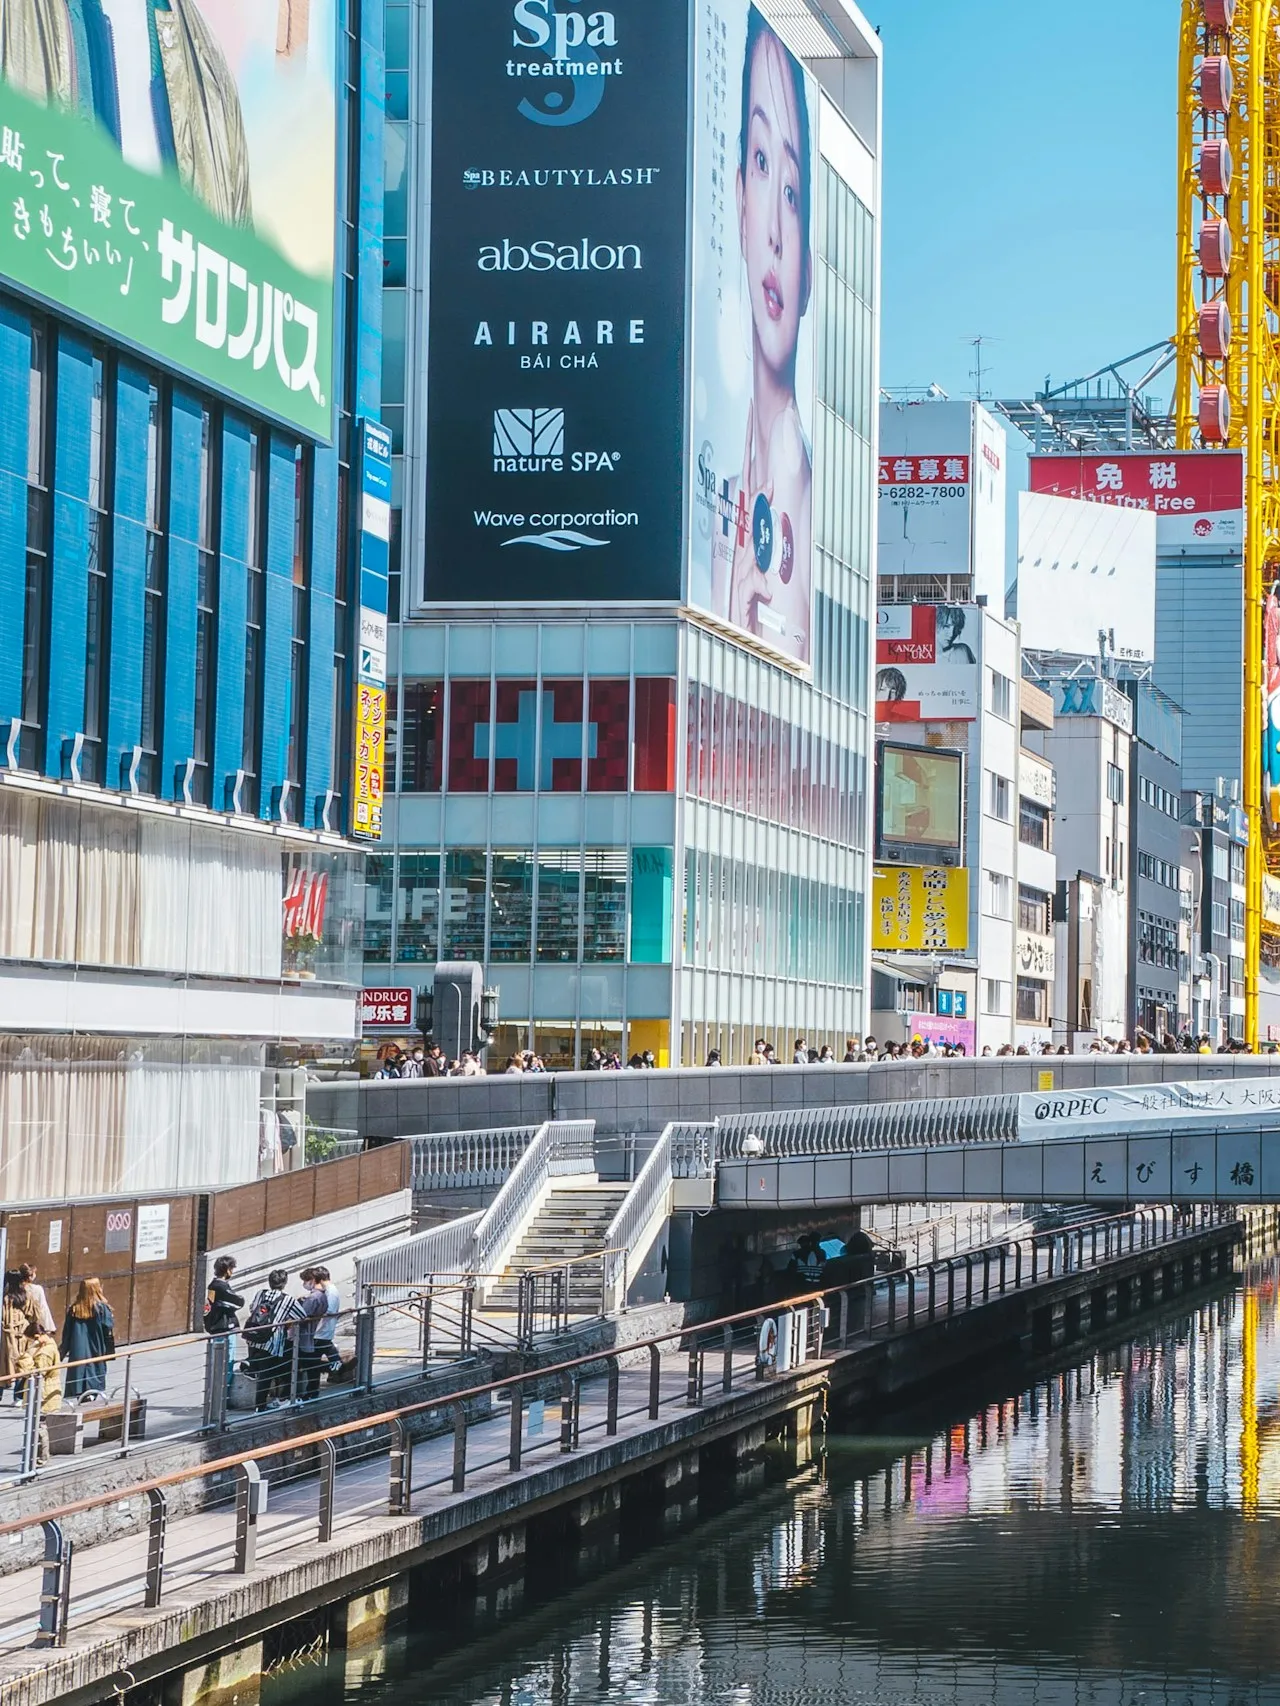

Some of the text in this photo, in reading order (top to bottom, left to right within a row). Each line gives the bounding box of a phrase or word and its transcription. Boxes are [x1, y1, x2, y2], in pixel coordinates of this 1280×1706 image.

[512, 0, 619, 61] Spa
[506, 58, 623, 76] treatment
[0, 126, 149, 252] 貼って、寝て、
[477, 239, 643, 271] abSalon
[474, 319, 645, 345] AIRARE
[520, 352, 599, 369] BÁI CHÁ
[493, 456, 564, 473] nature
[697, 453, 716, 497] Spa
[1095, 462, 1177, 490] 免税
[1154, 494, 1196, 510] Free
[473, 510, 639, 531] Wave corporation
[365, 887, 469, 921] LIFE
[1091, 1161, 1255, 1187] えびす橋
